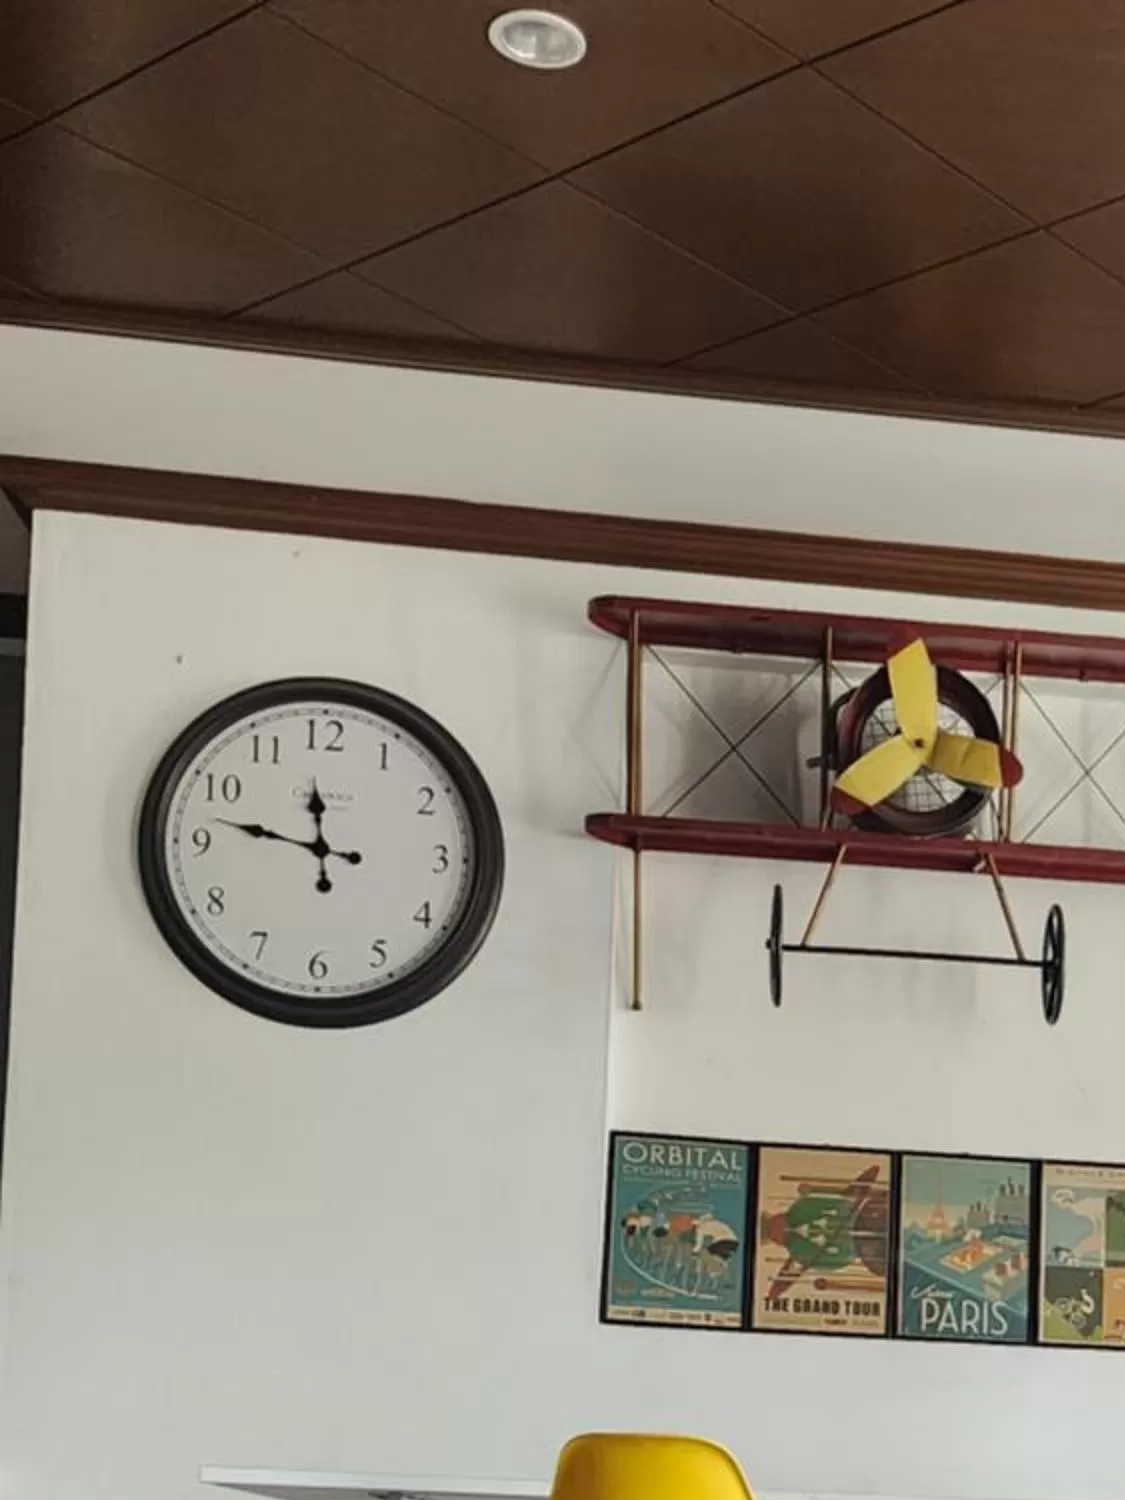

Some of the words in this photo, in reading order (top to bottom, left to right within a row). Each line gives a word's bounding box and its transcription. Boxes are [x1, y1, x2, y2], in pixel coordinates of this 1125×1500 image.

[251, 734, 280, 765] 11
[305, 718, 345, 752] 12
[379, 742, 389, 771] 1
[205, 773, 241, 803] 10
[416, 786, 436, 816] 2
[192, 827, 212, 857] 9
[431, 845, 449, 874] 3
[206, 886, 225, 917] 8
[413, 901, 433, 929] 4
[250, 931, 269, 961] 7
[368, 938, 388, 968] 5
[308, 951, 328, 980] 6
[623, 1141, 742, 1171] ORBITAL
[764, 1296, 789, 1313] THE
[792, 1298, 841, 1315] GRAND
[844, 1300, 881, 1317] TOUR
[921, 1297, 1008, 1335] PARIS
